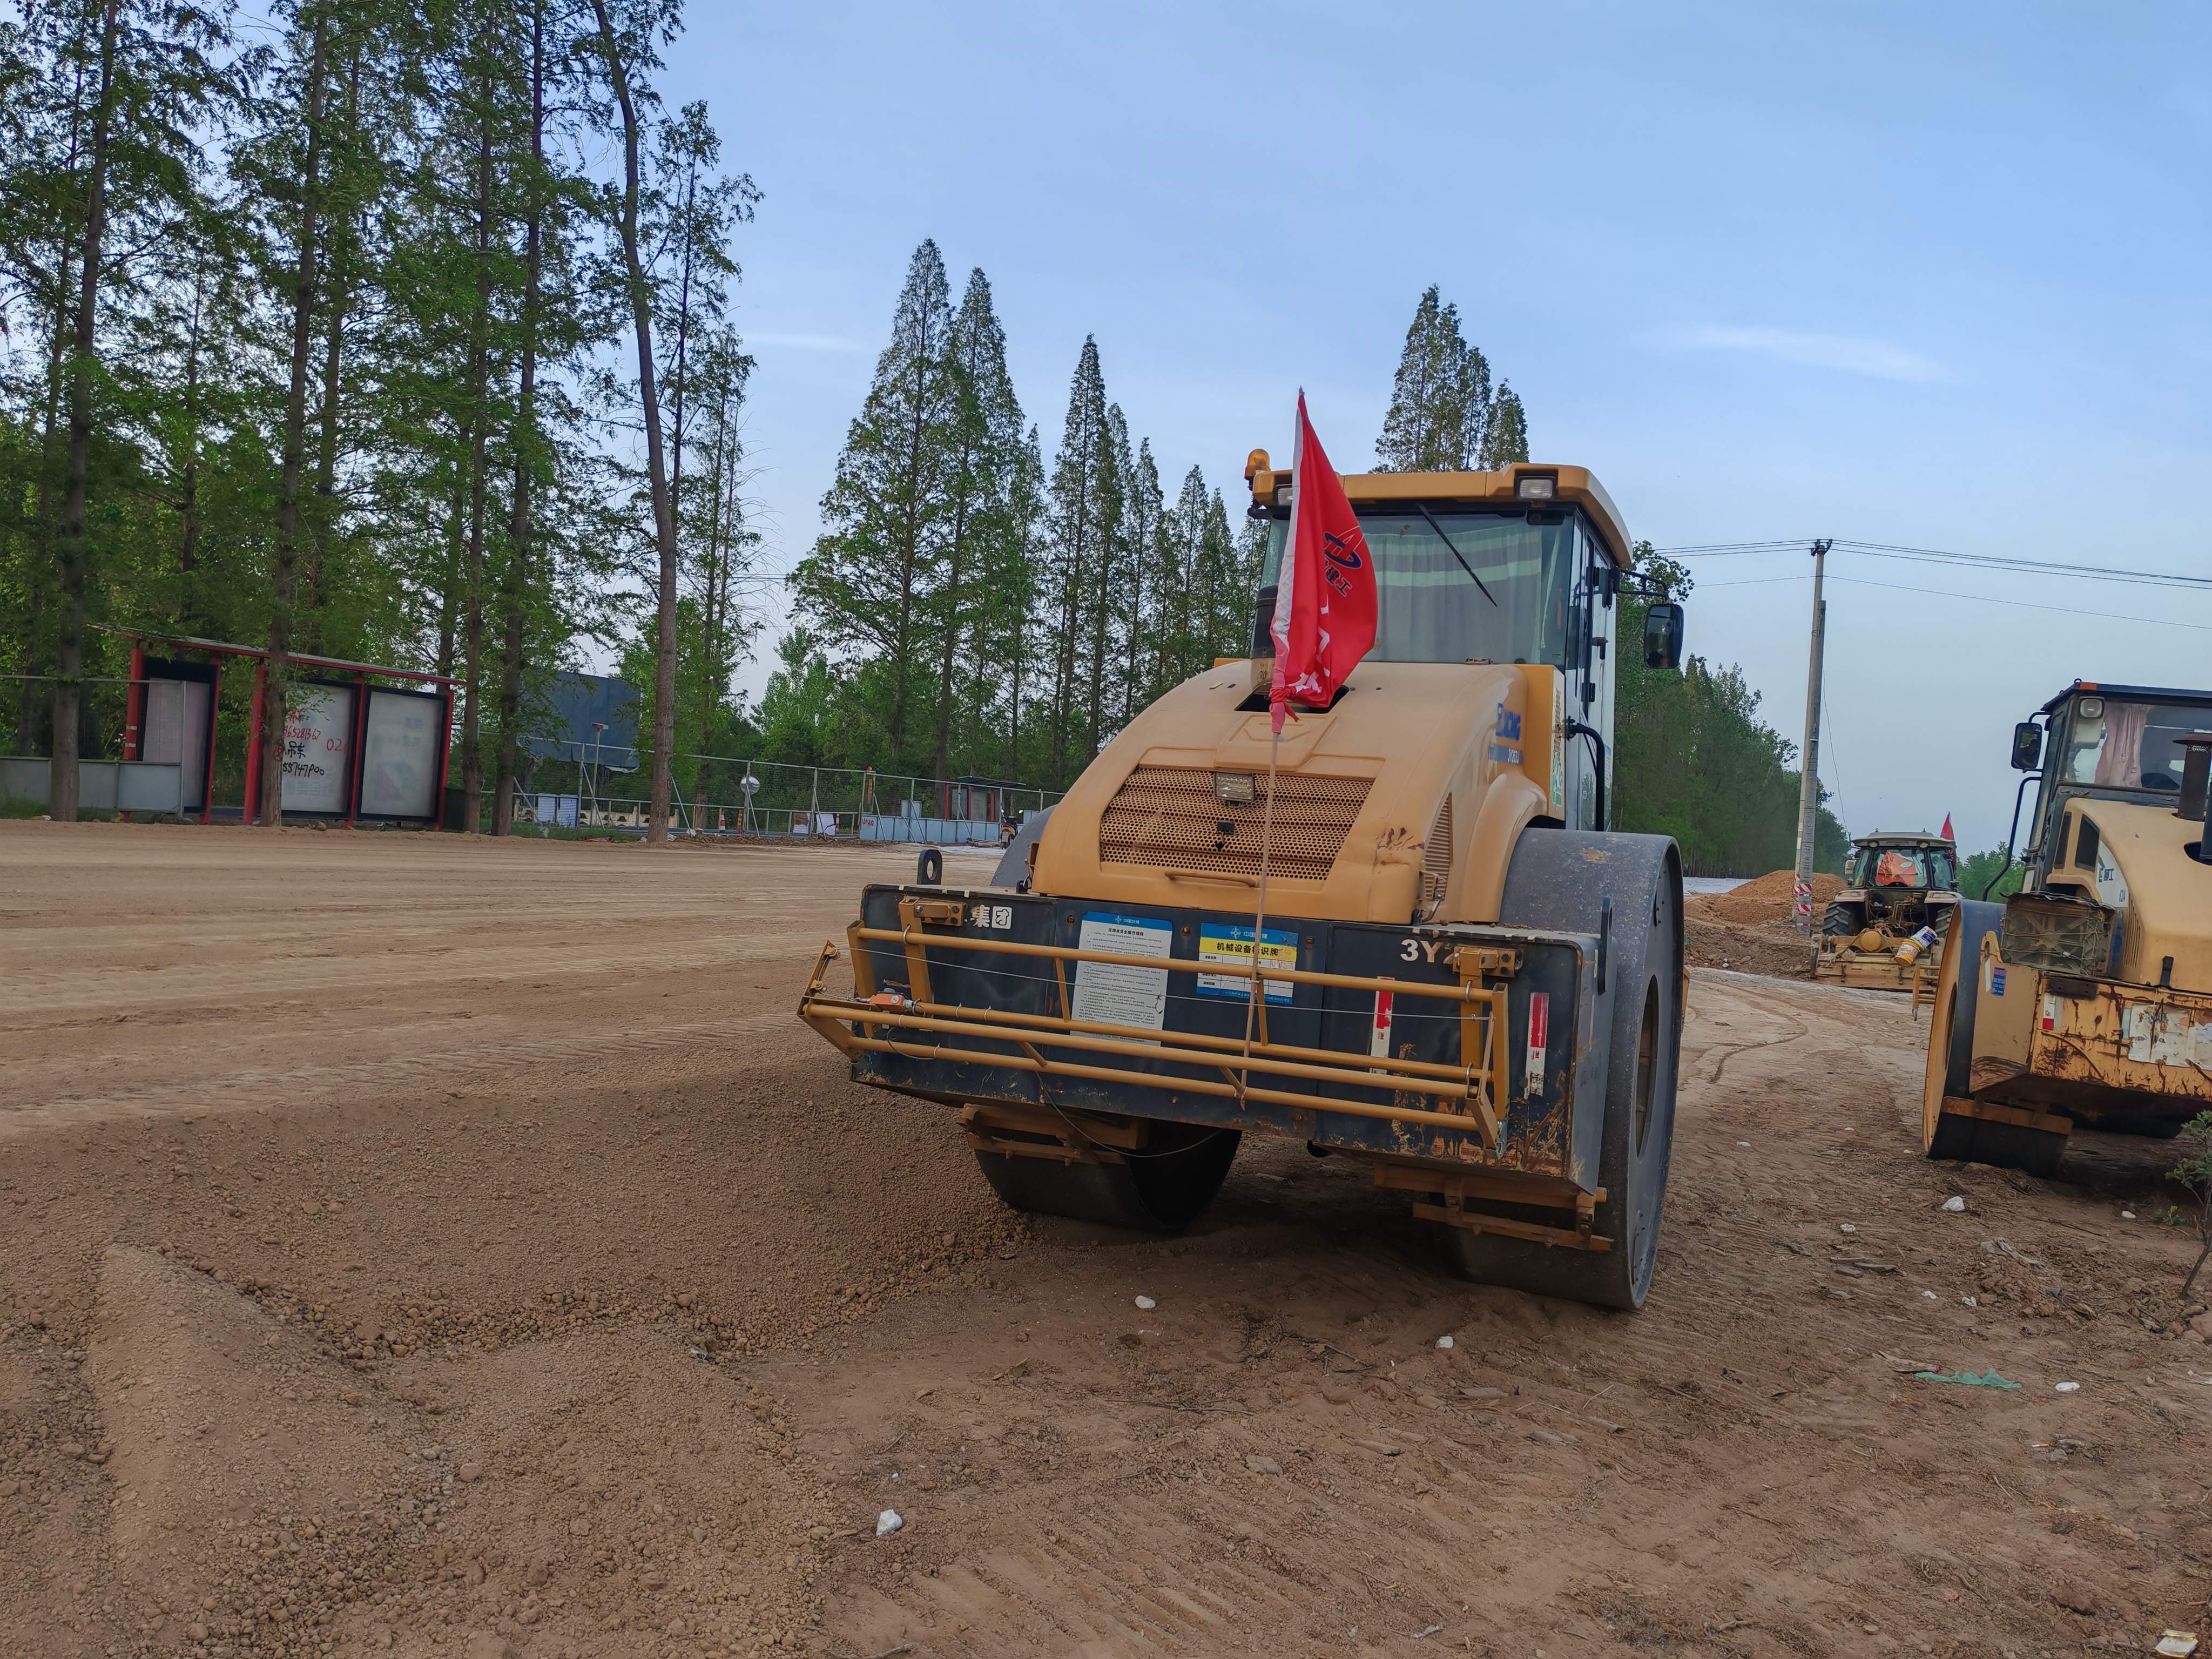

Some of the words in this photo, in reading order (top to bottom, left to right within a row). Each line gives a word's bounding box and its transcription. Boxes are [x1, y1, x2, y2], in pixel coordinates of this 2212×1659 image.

[1324, 558, 1353, 597] 建工
[1243, 931, 1268, 939] 中国建
